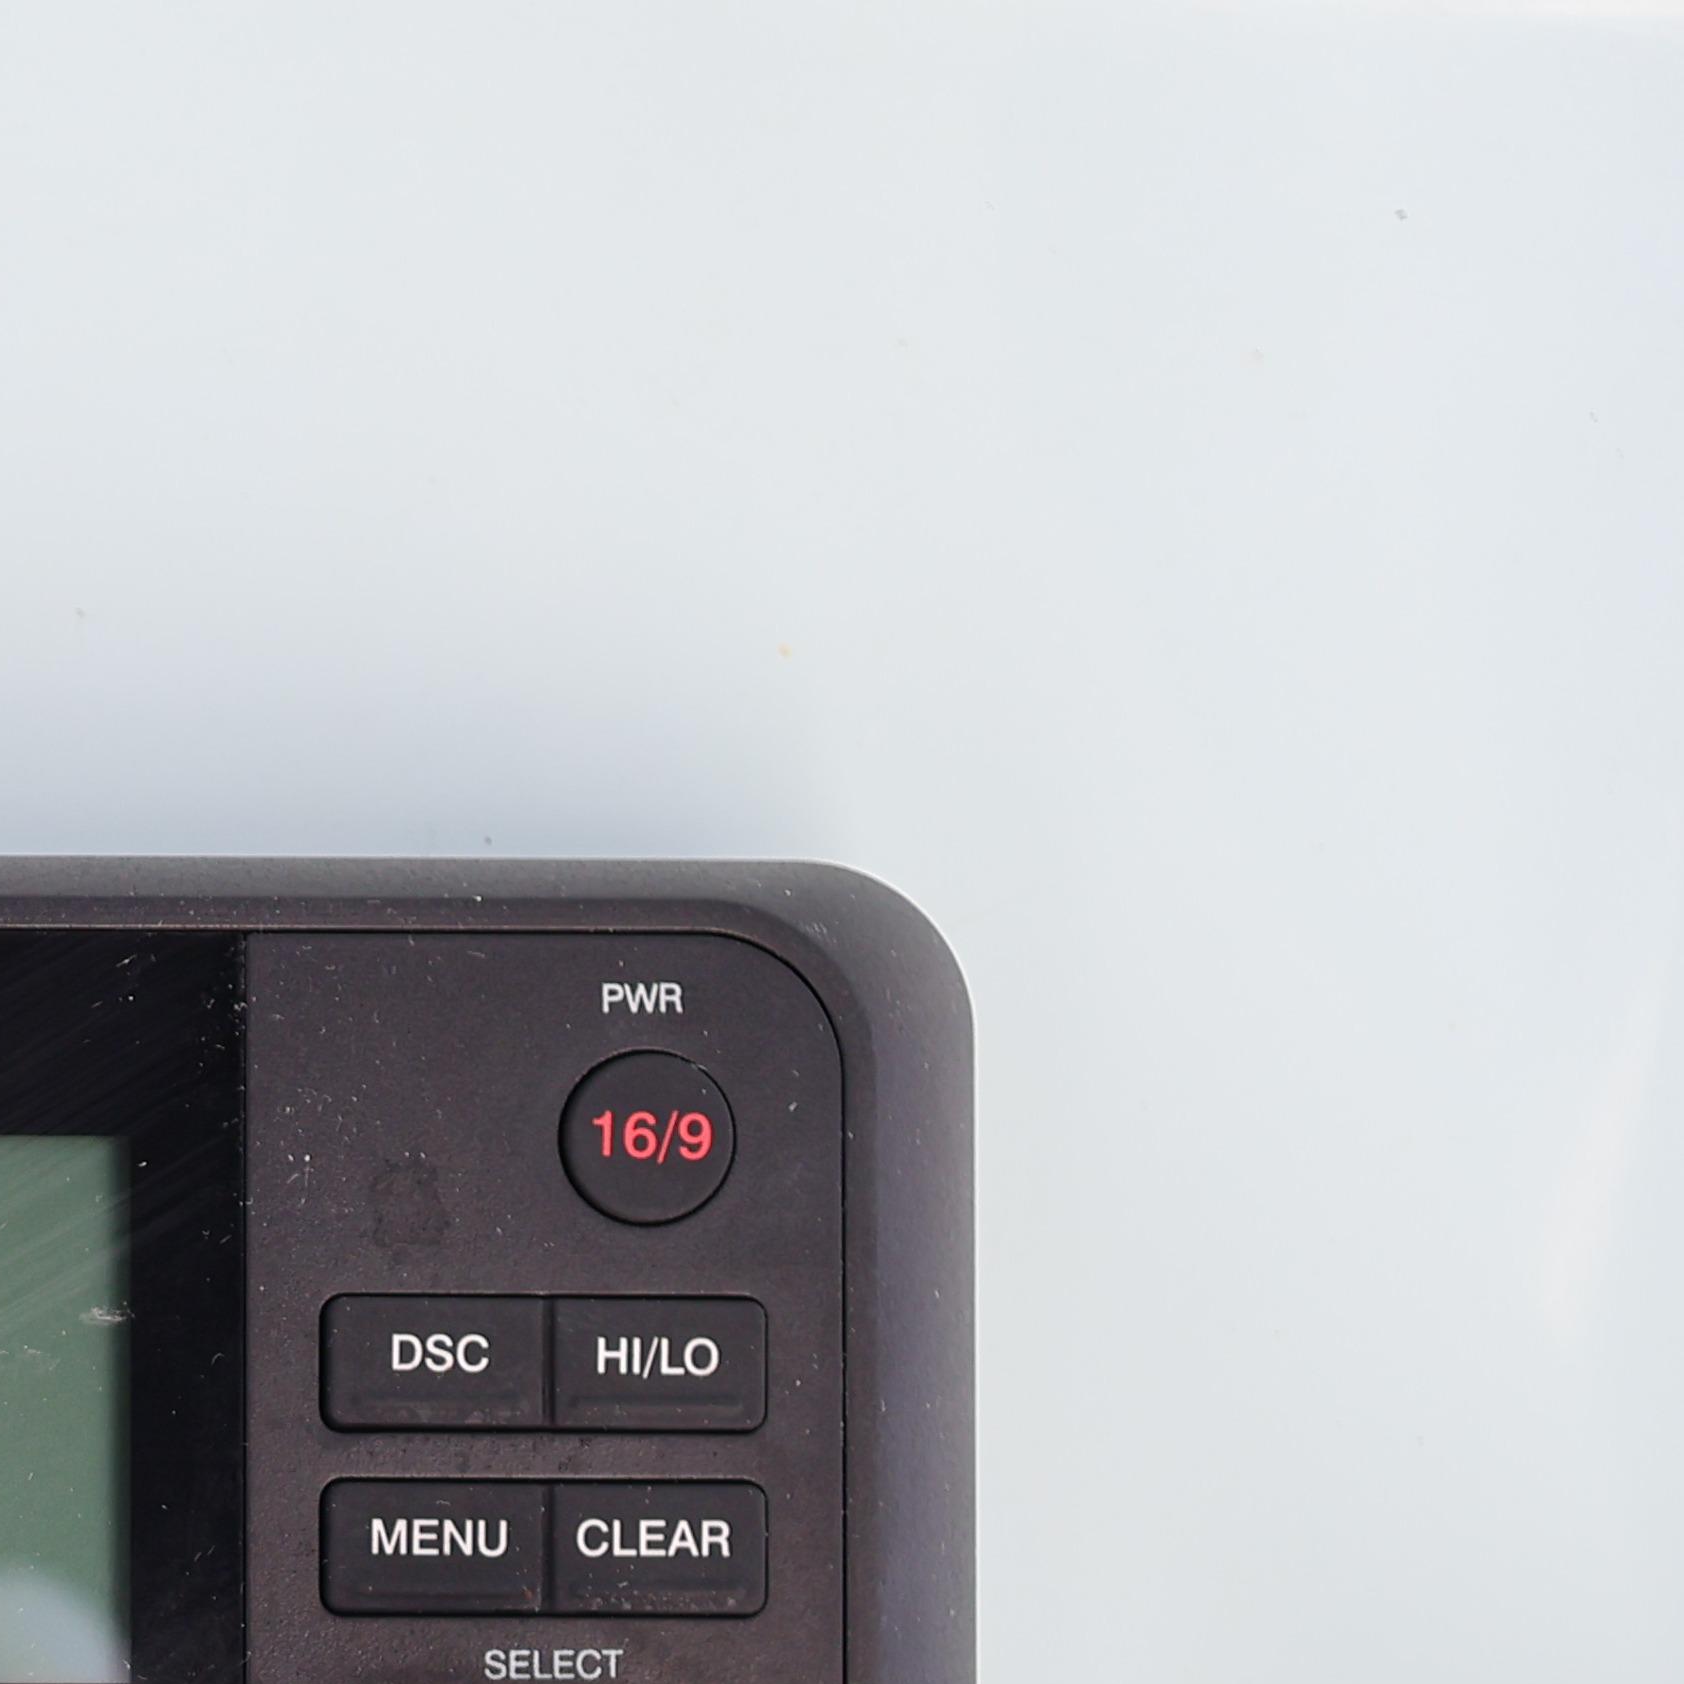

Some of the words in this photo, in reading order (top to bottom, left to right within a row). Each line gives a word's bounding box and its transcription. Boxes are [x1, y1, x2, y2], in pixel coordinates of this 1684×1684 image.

[601, 981, 684, 1015] PWR
[592, 1109, 713, 1164] 16/9
[391, 1332, 490, 1374] DSC
[596, 1336, 720, 1380] HI/LO
[370, 1517, 508, 1558] MENU
[575, 1517, 731, 1558] CLEAR
[483, 1647, 625, 1681] SELECT
